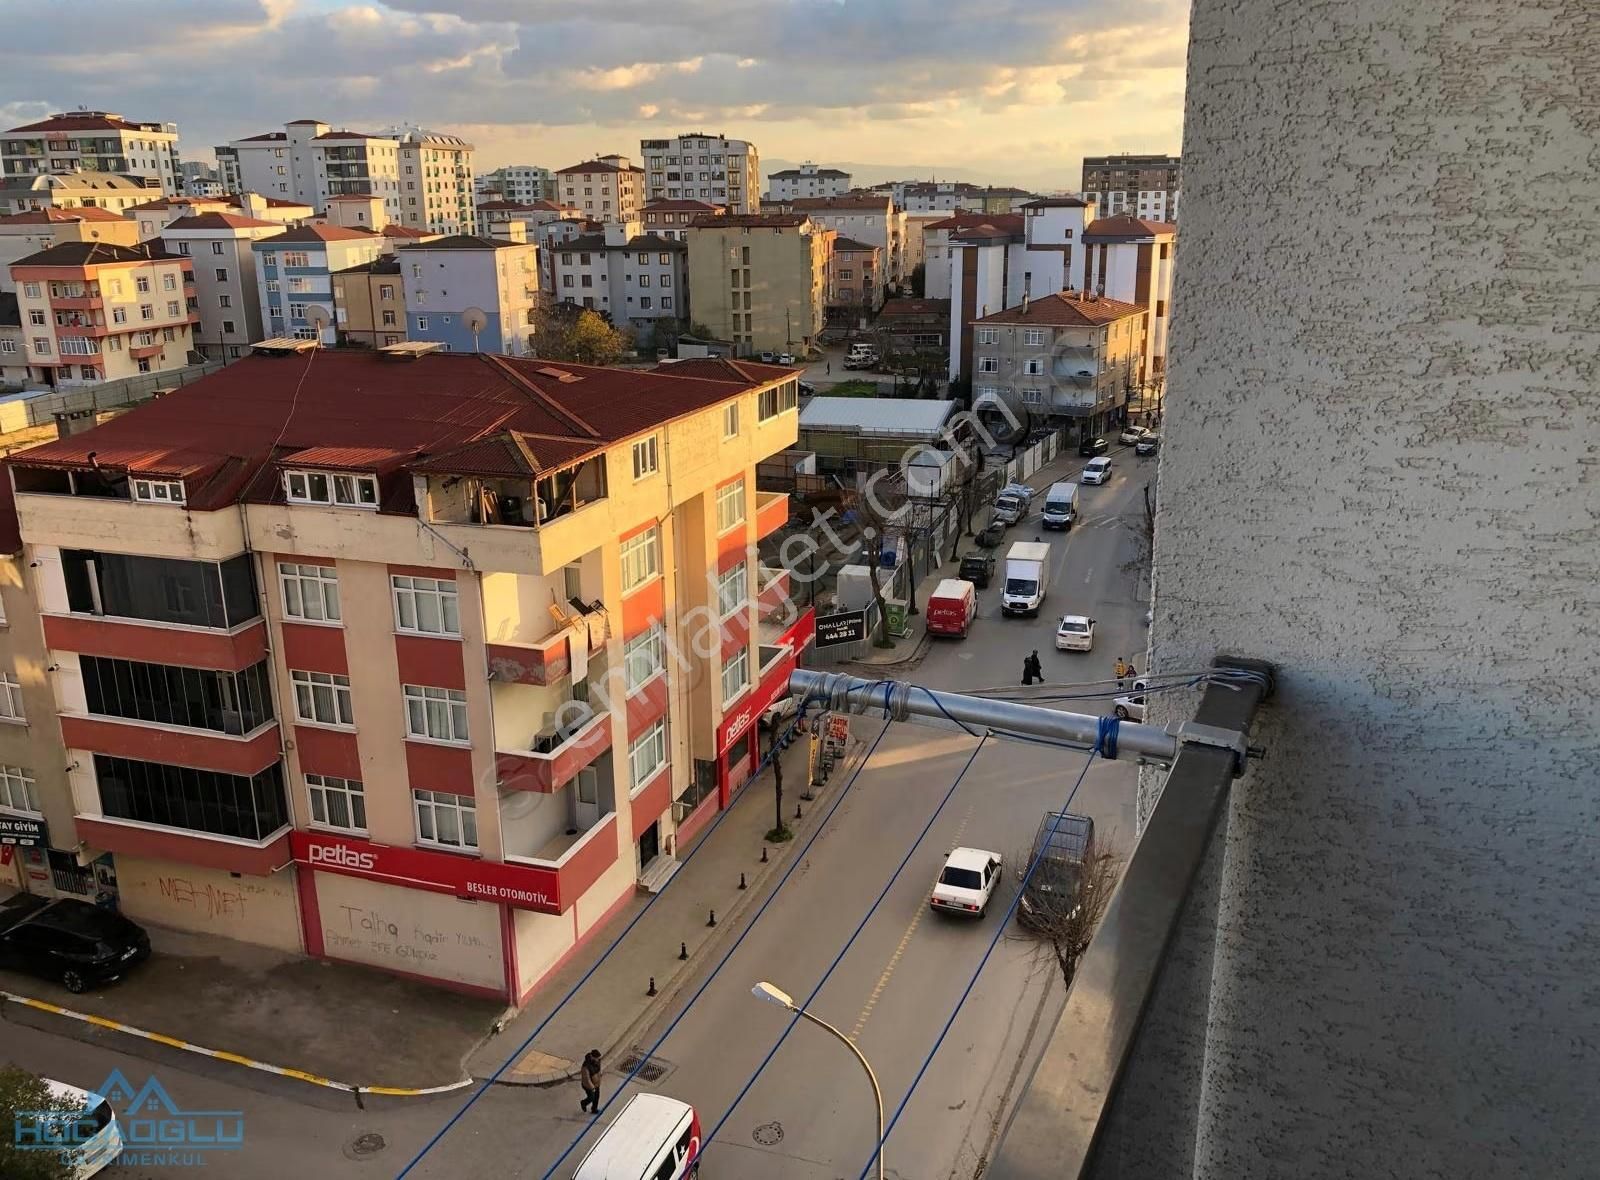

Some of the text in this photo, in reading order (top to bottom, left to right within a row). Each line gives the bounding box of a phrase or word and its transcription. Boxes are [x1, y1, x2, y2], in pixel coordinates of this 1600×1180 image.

[14, 821, 39, 833] GİYİM
[308, 844, 374, 869] petlas
[466, 881, 548, 905] BESLER OTOMOTİV
